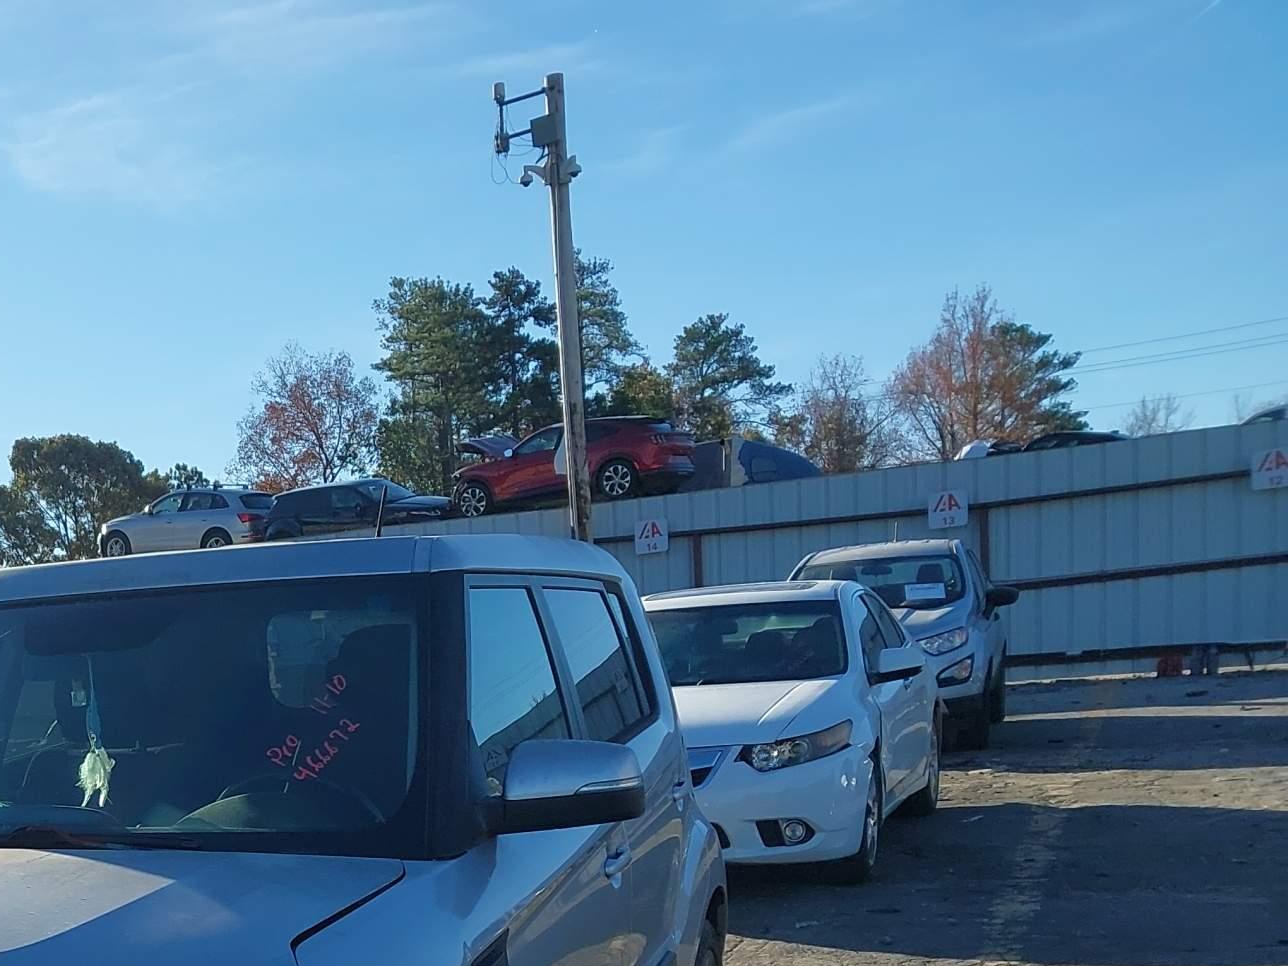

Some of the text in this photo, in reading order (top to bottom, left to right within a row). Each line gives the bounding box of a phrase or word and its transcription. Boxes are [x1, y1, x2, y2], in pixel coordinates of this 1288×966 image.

[941, 516, 955, 526] 13
[647, 543, 658, 552] 14
[310, 674, 347, 715] 11-10
